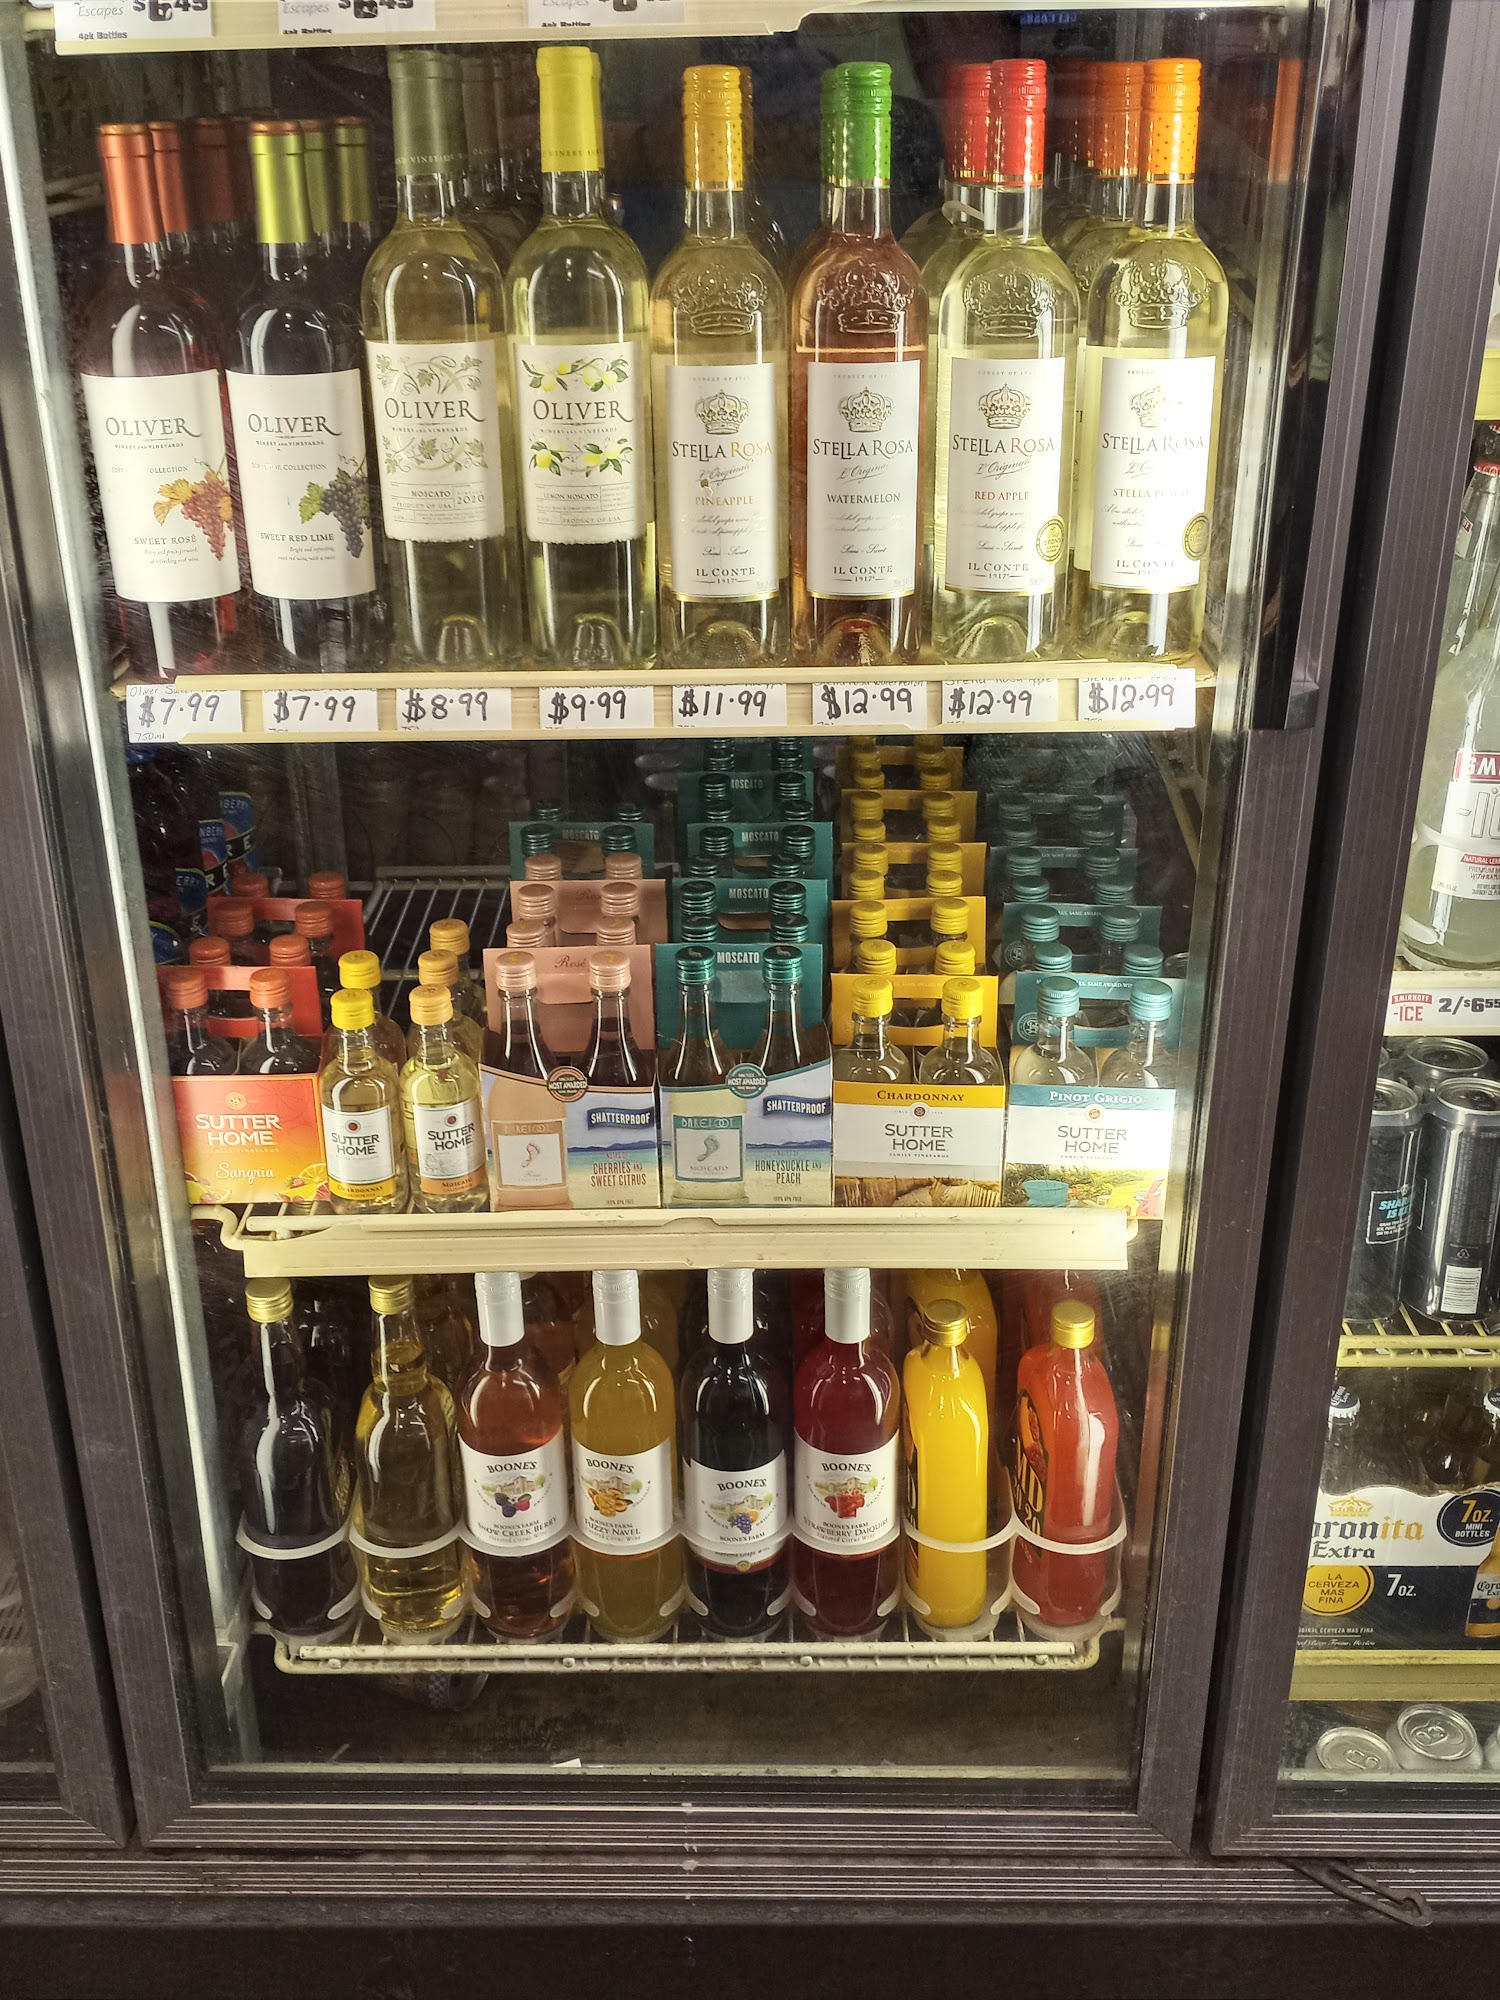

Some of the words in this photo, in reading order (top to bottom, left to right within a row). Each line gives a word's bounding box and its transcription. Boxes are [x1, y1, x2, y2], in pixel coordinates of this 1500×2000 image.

[78, 5, 124, 20] Escapes
[283, 2, 329, 15] Escapes
[97, 31, 128, 39] Bottles
[384, 397, 487, 422] OLIVER
[533, 399, 634, 422] OLIVER
[105, 417, 201, 438] OLIVER
[247, 413, 343, 436] OLIVER
[813, 438, 869, 459] STELLA
[873, 439, 914, 459] ROSA
[952, 434, 1007, 457] STELLA
[1010, 436, 1055, 457] ROSA
[1101, 432, 1158, 455] STELLA
[671, 441, 726, 462] STELLA
[730, 441, 774, 462] ROSA
[149, 465, 188, 474] OLLECTION
[283, 462, 327, 471] COLLECTION
[411, 490, 451, 498] MOSCATO
[457, 494, 485, 505] 2020
[826, 493, 901, 504] WATERMELON
[974, 491, 996, 501] RED
[998, 491, 1029, 501] APPLE
[1113, 488, 1151, 498] STELLA
[695, 495, 754, 506] PINEAPPLE
[134, 536, 167, 545] SWEET
[171, 534, 197, 544] ROSÉ
[260, 532, 286, 542] SWEET
[288, 533, 308, 542] RED
[311, 533, 335, 542] LIME
[833, 566, 845, 575] IL
[849, 565, 893, 575] CONTE
[968, 562, 980, 571] IL
[983, 562, 1029, 571] CONTE
[1116, 560, 1128, 568] IL
[696, 568, 708, 577] IL
[711, 566, 756, 577] CONTE
[129, 686, 158, 697] Oliver
[1088, 682, 1175, 714] $12.99
[274, 690, 357, 723] $7.99
[402, 689, 489, 723] $8.99
[548, 689, 627, 725] $9.99
[678, 688, 768, 718] $11.99
[821, 684, 912, 720] $12.99
[948, 686, 1032, 719] $12.99
[139, 692, 220, 728] $7.99
[562, 829, 600, 841] MOSCATO
[741, 831, 779, 842] MOSCATO
[1463, 854, 1488, 864] NATURAL
[1468, 866, 1495, 874] PREMIUM
[576, 887, 599, 900] Ros
[729, 887, 769, 899] MOSCATO
[554, 955, 588, 968] Rosé
[717, 951, 760, 964] MOSCATO
[1394, 994, 1430, 1003] SMIRNOFF
[548, 1082, 563, 1090] MOST
[563, 1081, 588, 1089] AWARDED
[742, 1077, 767, 1085] AWARDED
[876, 1090, 965, 1102] CHARDONNAY
[1049, 1091, 1090, 1103] PINOT
[1094, 1092, 1143, 1104] GRIGIO
[766, 1101, 827, 1114] SHATTERPROOF
[195, 1113, 283, 1130] SUTTER
[590, 1111, 651, 1125] SHATTERPROOF
[682, 1117, 734, 1129] BAREFOOT
[427, 1122, 476, 1141] SUTTER
[884, 1123, 954, 1138] SUTTER
[1058, 1125, 1127, 1141] SUTTER
[207, 1130, 275, 1146] HOME
[331, 1132, 380, 1144] SUTTER
[434, 1135, 474, 1151] HOME
[892, 1138, 946, 1151] HOME
[336, 1144, 377, 1156] HOME
[1064, 1140, 1119, 1154] HOME
[593, 1161, 632, 1175] CHERRIES
[755, 1159, 810, 1171] HONEYSUCKLE
[215, 1162, 276, 1185] Sangria
[776, 1172, 801, 1185] PEACH
[441, 1176, 474, 1189] MOSCATO
[590, 1175, 617, 1188] SWEET
[618, 1173, 647, 1187] CITRUS
[337, 1184, 384, 1194] CHARDONNAY
[502, 1527, 532, 1537] CREEK
[533, 1516, 557, 1532] BERRY
[584, 1518, 610, 1535] FUZZY
[612, 1528, 641, 1536] NAVEL
[803, 1516, 852, 1537] STRAWBERRY
[855, 1517, 889, 1537] DAIQUIRI
[1454, 1530, 1491, 1538] BOTTLES
[1312, 1540, 1376, 1559] Extra
[1308, 1581, 1360, 1589] CERVEZA
